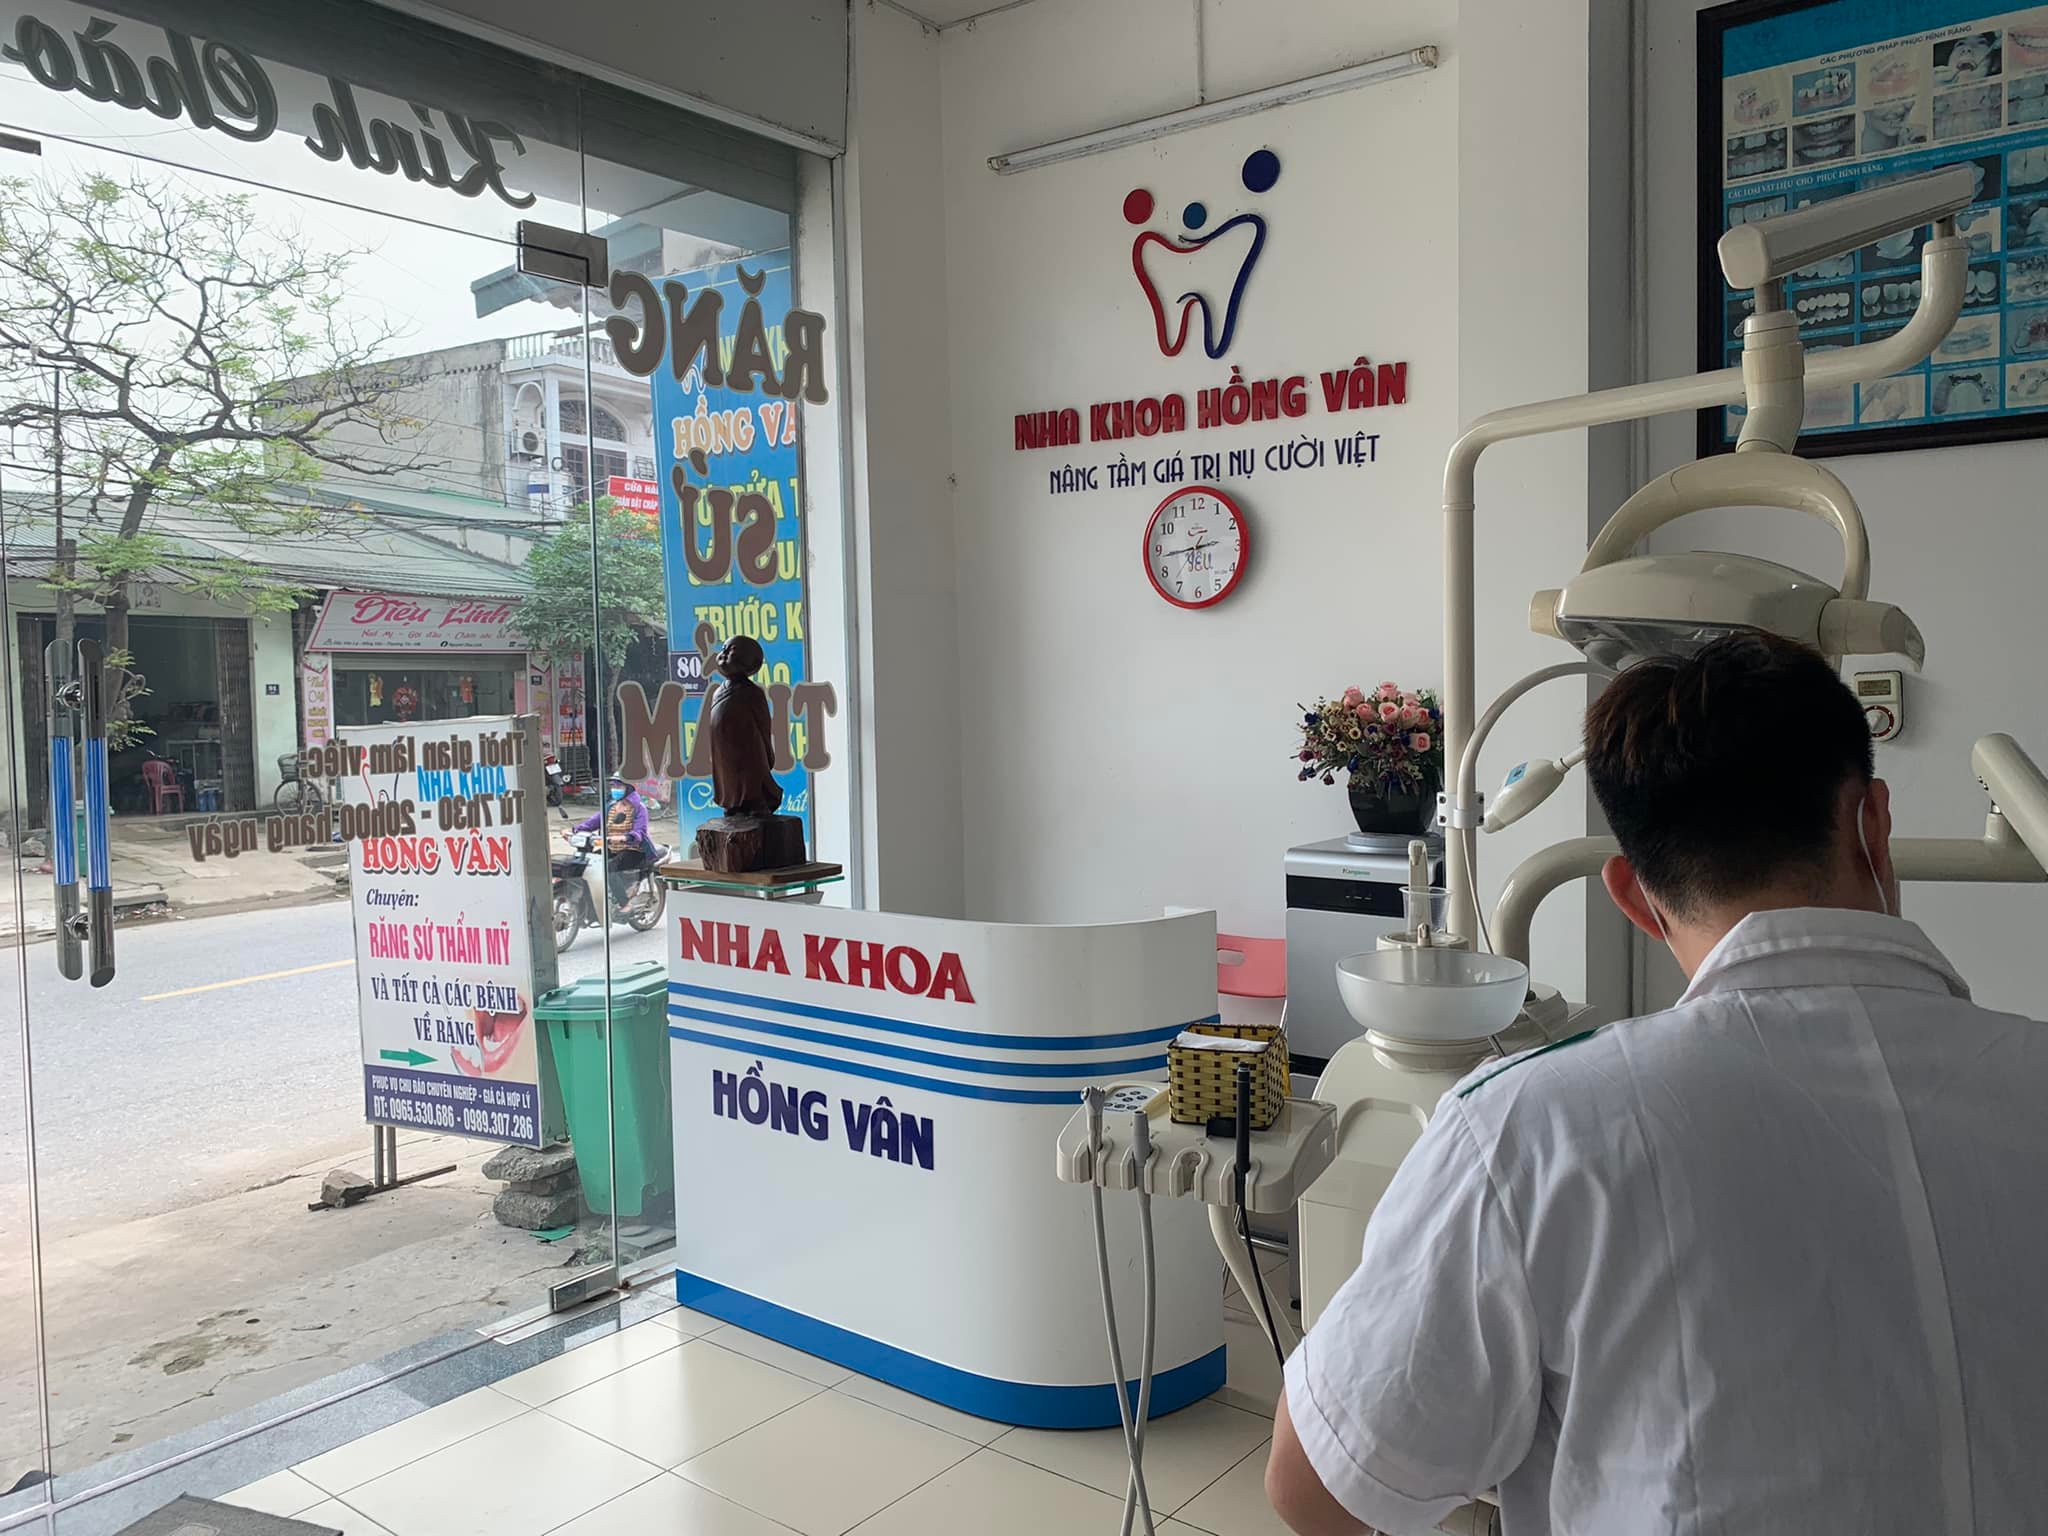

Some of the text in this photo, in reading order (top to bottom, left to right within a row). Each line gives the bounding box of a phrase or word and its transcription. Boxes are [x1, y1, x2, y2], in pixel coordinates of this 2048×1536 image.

[1014, 356, 1408, 450] NHA KHOA HỒNG VÂN
[1049, 430, 1380, 495] NÂNG TẦM GIÁ TRỊ NỤ CƯỜI VIỆT
[1172, 506, 1185, 518] 11
[1190, 497, 1205, 510] 12
[1215, 503, 1220, 515] 1
[1161, 522, 1174, 535] 10
[1229, 518, 1237, 530] 2
[1155, 544, 1162, 556] 9
[1161, 565, 1169, 578] 8
[1229, 562, 1236, 572] 4
[1176, 581, 1183, 593] 7
[1194, 586, 1202, 599] 6
[1214, 579, 1222, 591] 5
[676, 656, 700, 679] 80
[417, 764, 454, 801] NHA
[445, 827, 511, 876] VÂN
[366, 888, 419, 911] Chuyên:
[369, 911, 510, 966] RĂNG SỨ THẨM MỸ
[678, 917, 976, 1004] NHA KHOA
[371, 972, 518, 1014] VÀ TẤT CẢ CÁC BỆNH
[413, 1010, 432, 1042] VỀ
[372, 1074, 388, 1092] PHỤC
[389, 1076, 398, 1094] VỤ
[483, 1086, 495, 1104] GIÁ
[496, 1086, 506, 1106] CẢ
[506, 1091, 521, 1110] HỢP
[522, 1090, 531, 1109] LÝ
[373, 1095, 388, 1118] ĐT:
[390, 1097, 455, 1128] 0965.530.686
[463, 1107, 534, 1140] 0989.307.286
[712, 1060, 934, 1171] HỒNG VÂN
